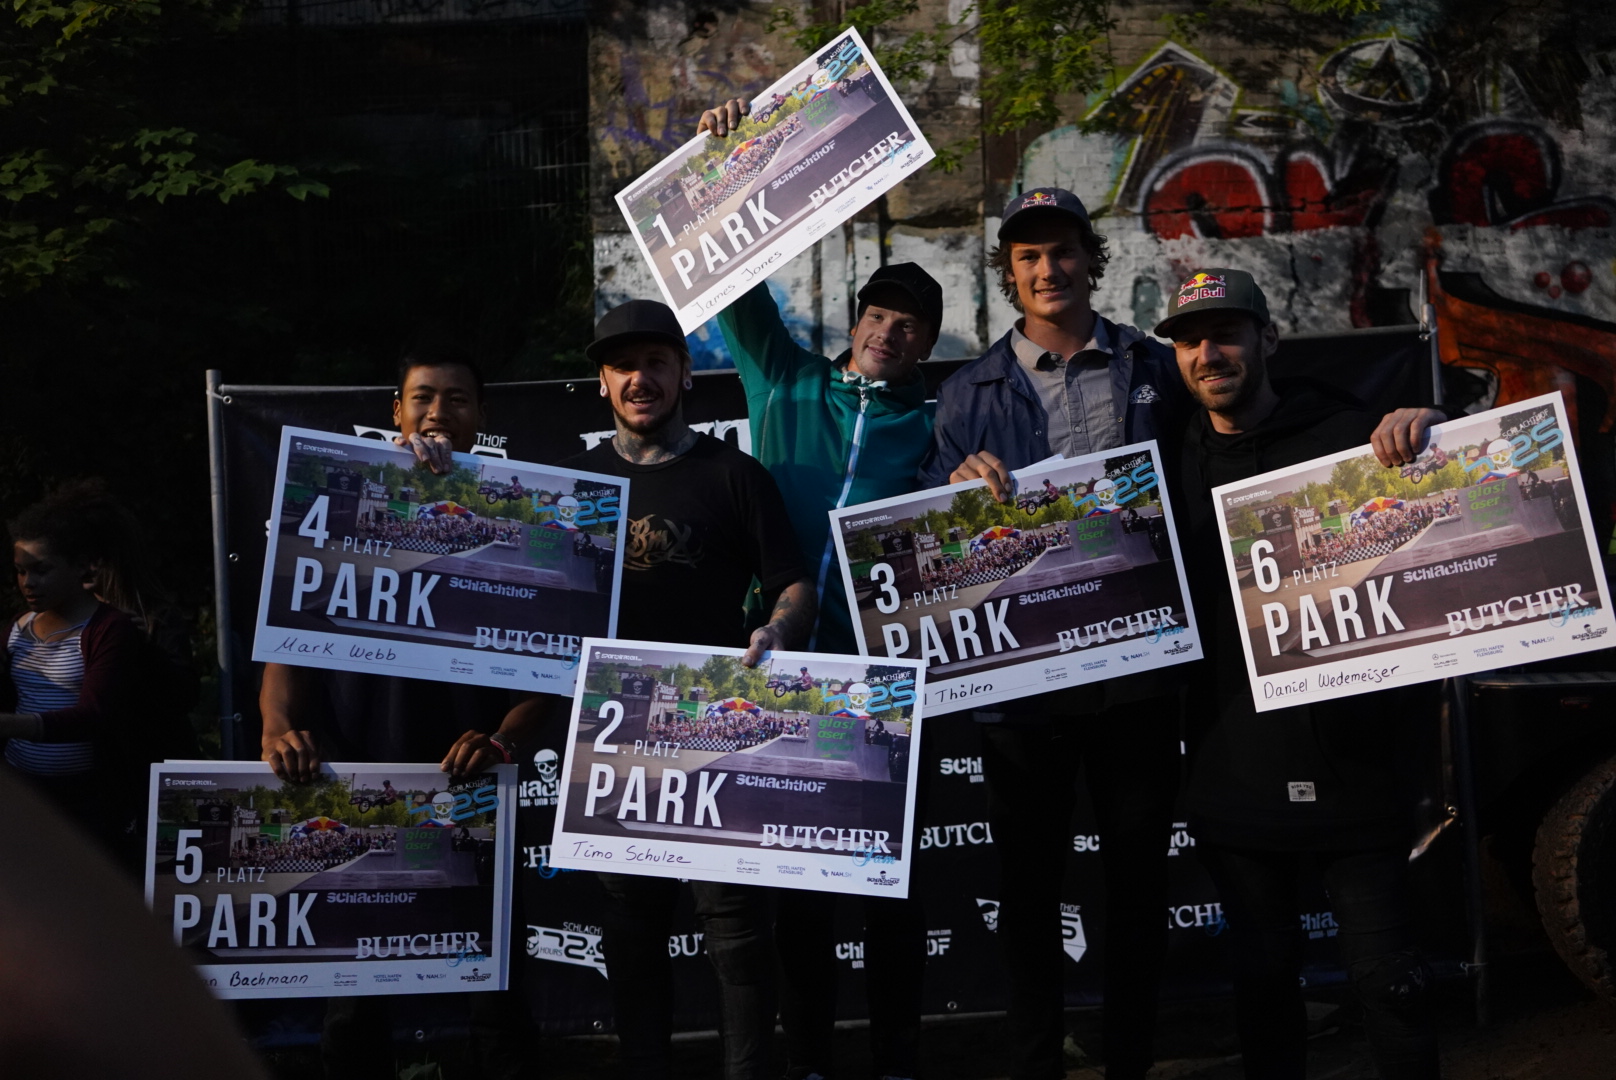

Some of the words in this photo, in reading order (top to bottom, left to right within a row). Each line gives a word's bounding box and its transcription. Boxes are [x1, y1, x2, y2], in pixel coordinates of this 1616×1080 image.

[808, 131, 906, 210] BUTCHER
[682, 204, 718, 235] PLATZ
[670, 189, 782, 290] PARK
[691, 284, 735, 317] James
[741, 251, 782, 282] Jones
[1178, 288, 1198, 308] Red
[1200, 287, 1225, 299] Bull
[476, 432, 508, 448] THOF
[343, 536, 393, 558] PLATZ
[1292, 560, 1339, 586] PLATZ
[290, 556, 442, 628] PARK
[913, 584, 958, 608] PLATZ
[1262, 575, 1406, 656] PARK
[1445, 583, 1590, 636] BUTCHER
[882, 598, 1020, 667] PARK
[1056, 606, 1178, 652] BUTCHER
[274, 636, 334, 656] Mark
[350, 644, 396, 661] Webb
[1264, 678, 1308, 699] Daniel
[634, 740, 680, 758] PLATZ
[584, 762, 728, 828] PARK
[573, 841, 612, 858] Timo
[626, 845, 691, 864] Schulze
[760, 824, 891, 854] BUTCHER
[217, 866, 266, 883] PLATZ
[172, 892, 318, 948] PARK
[356, 932, 482, 960] BUTCHER
[230, 970, 308, 987] Bachmann
